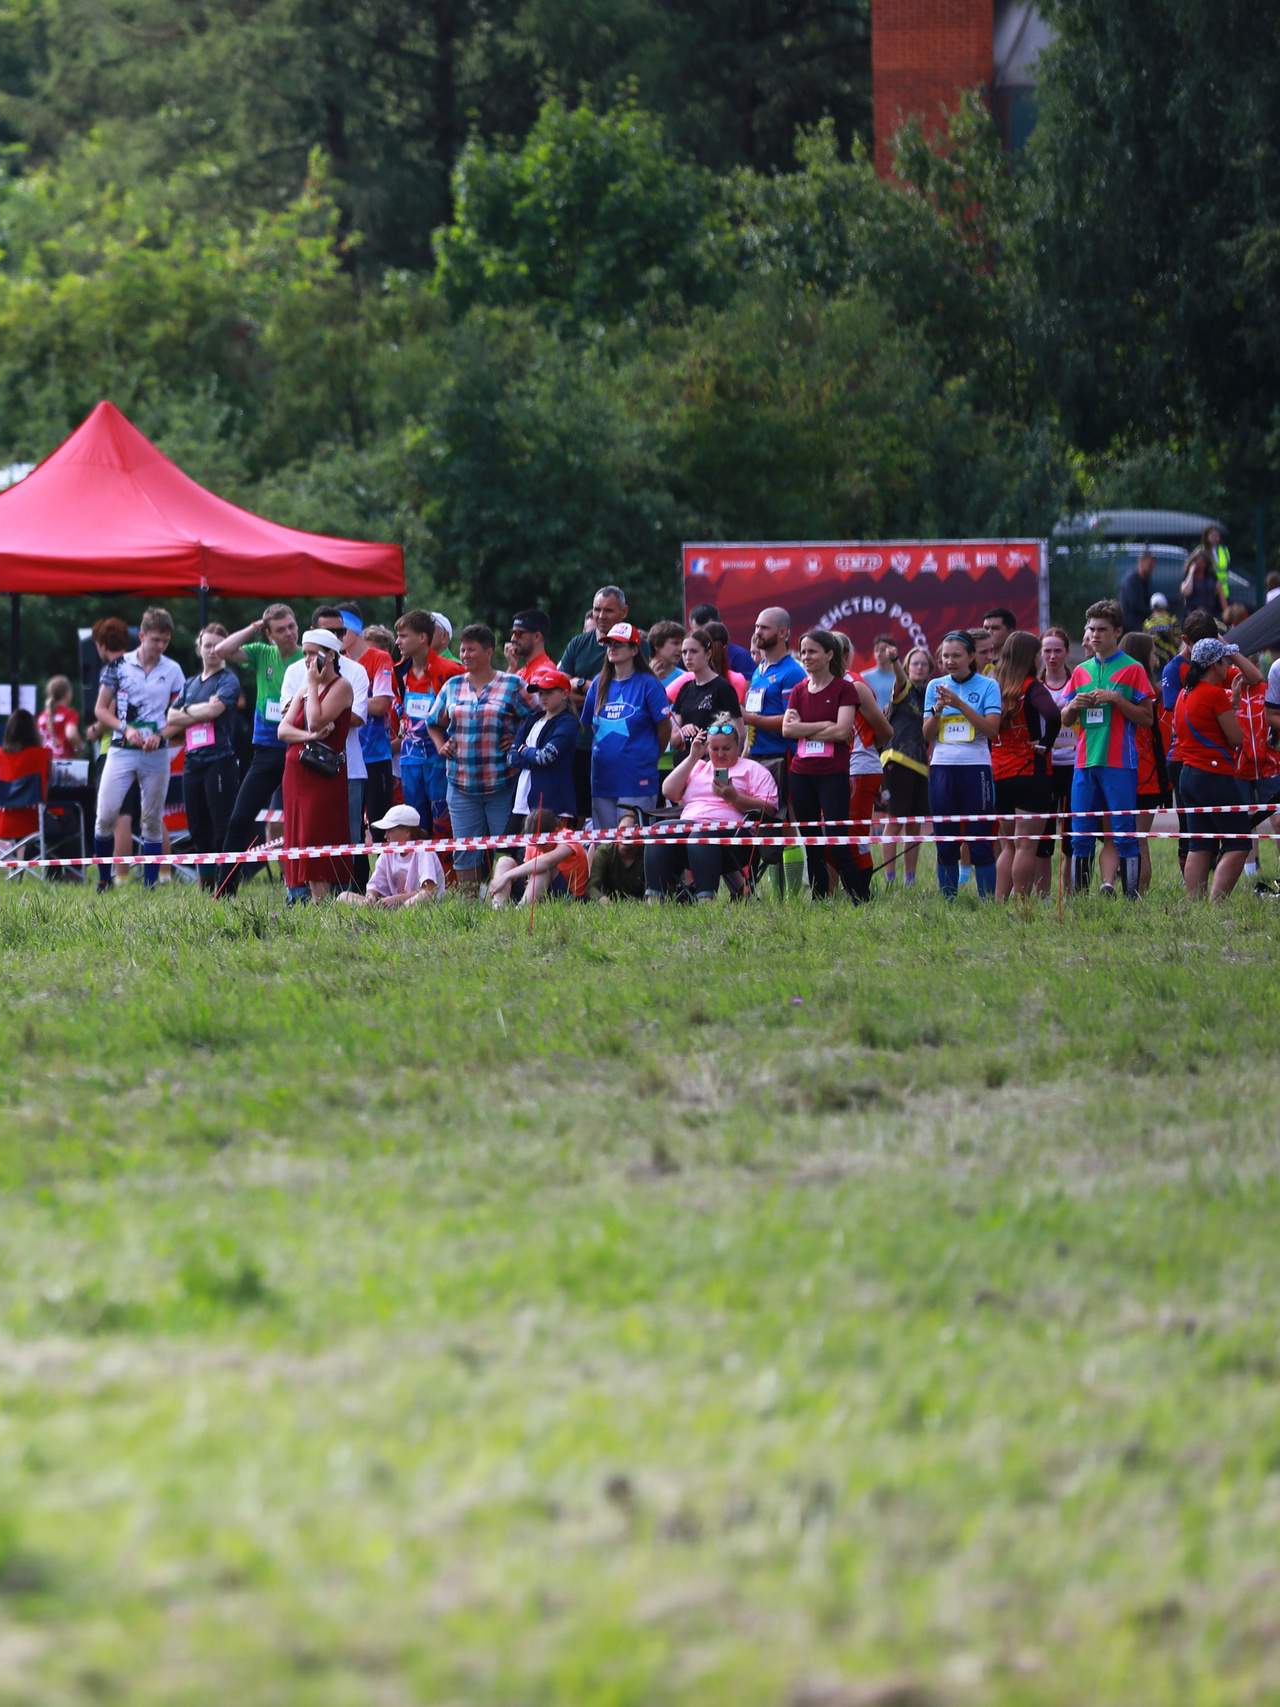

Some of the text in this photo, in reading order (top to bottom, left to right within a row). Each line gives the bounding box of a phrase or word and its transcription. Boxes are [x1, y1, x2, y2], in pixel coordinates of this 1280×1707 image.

[604, 704, 626, 712] SPORTY
[1087, 710, 1103, 719] 144.3
[947, 725, 966, 733] 244.3
